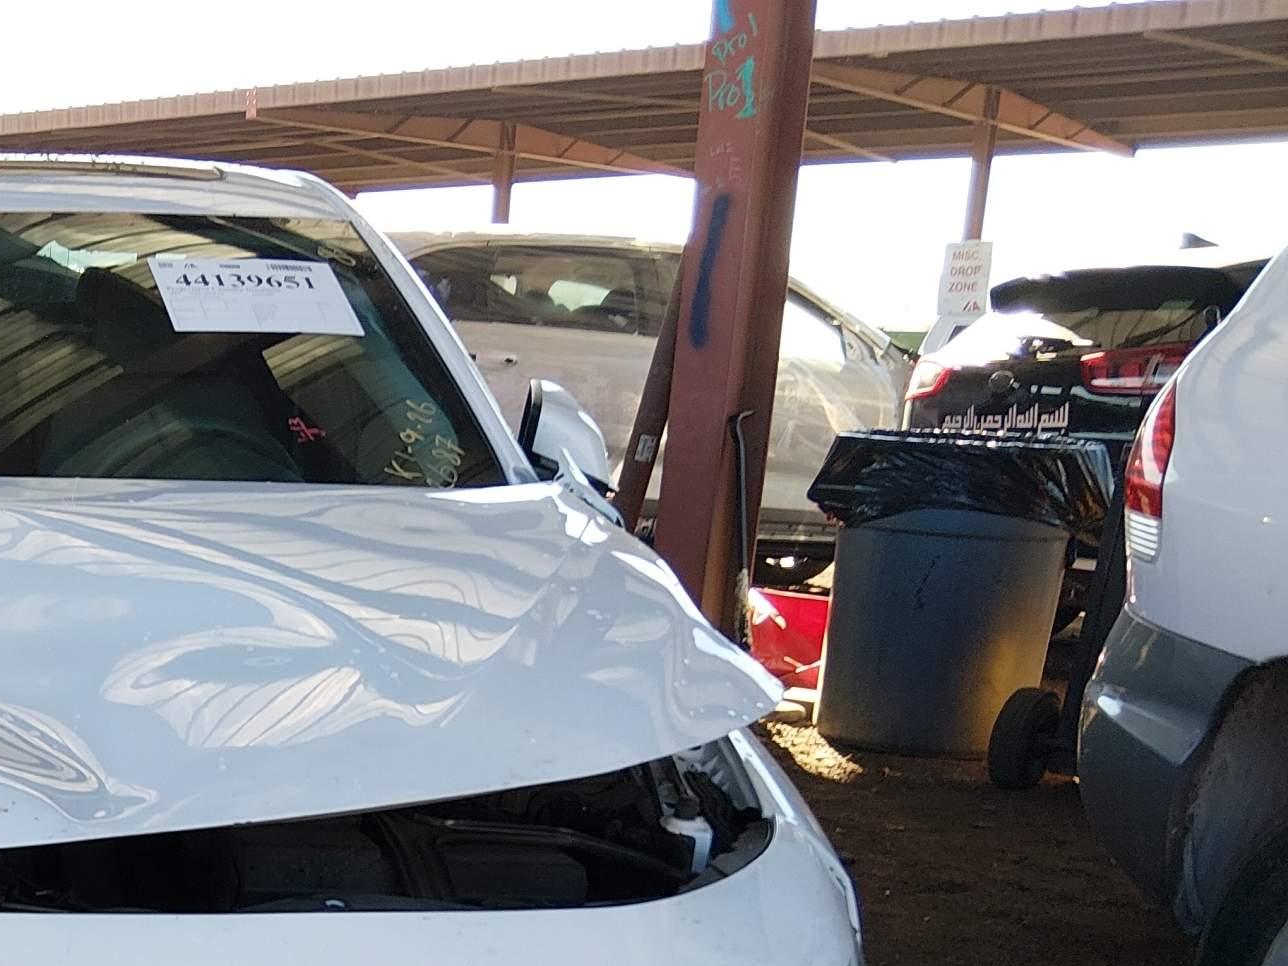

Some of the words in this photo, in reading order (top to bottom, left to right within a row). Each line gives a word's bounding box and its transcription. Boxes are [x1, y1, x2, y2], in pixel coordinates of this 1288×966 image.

[950, 265, 982, 277] DROP
[175, 273, 316, 290] 44139651
[948, 281, 978, 293] ZONE
